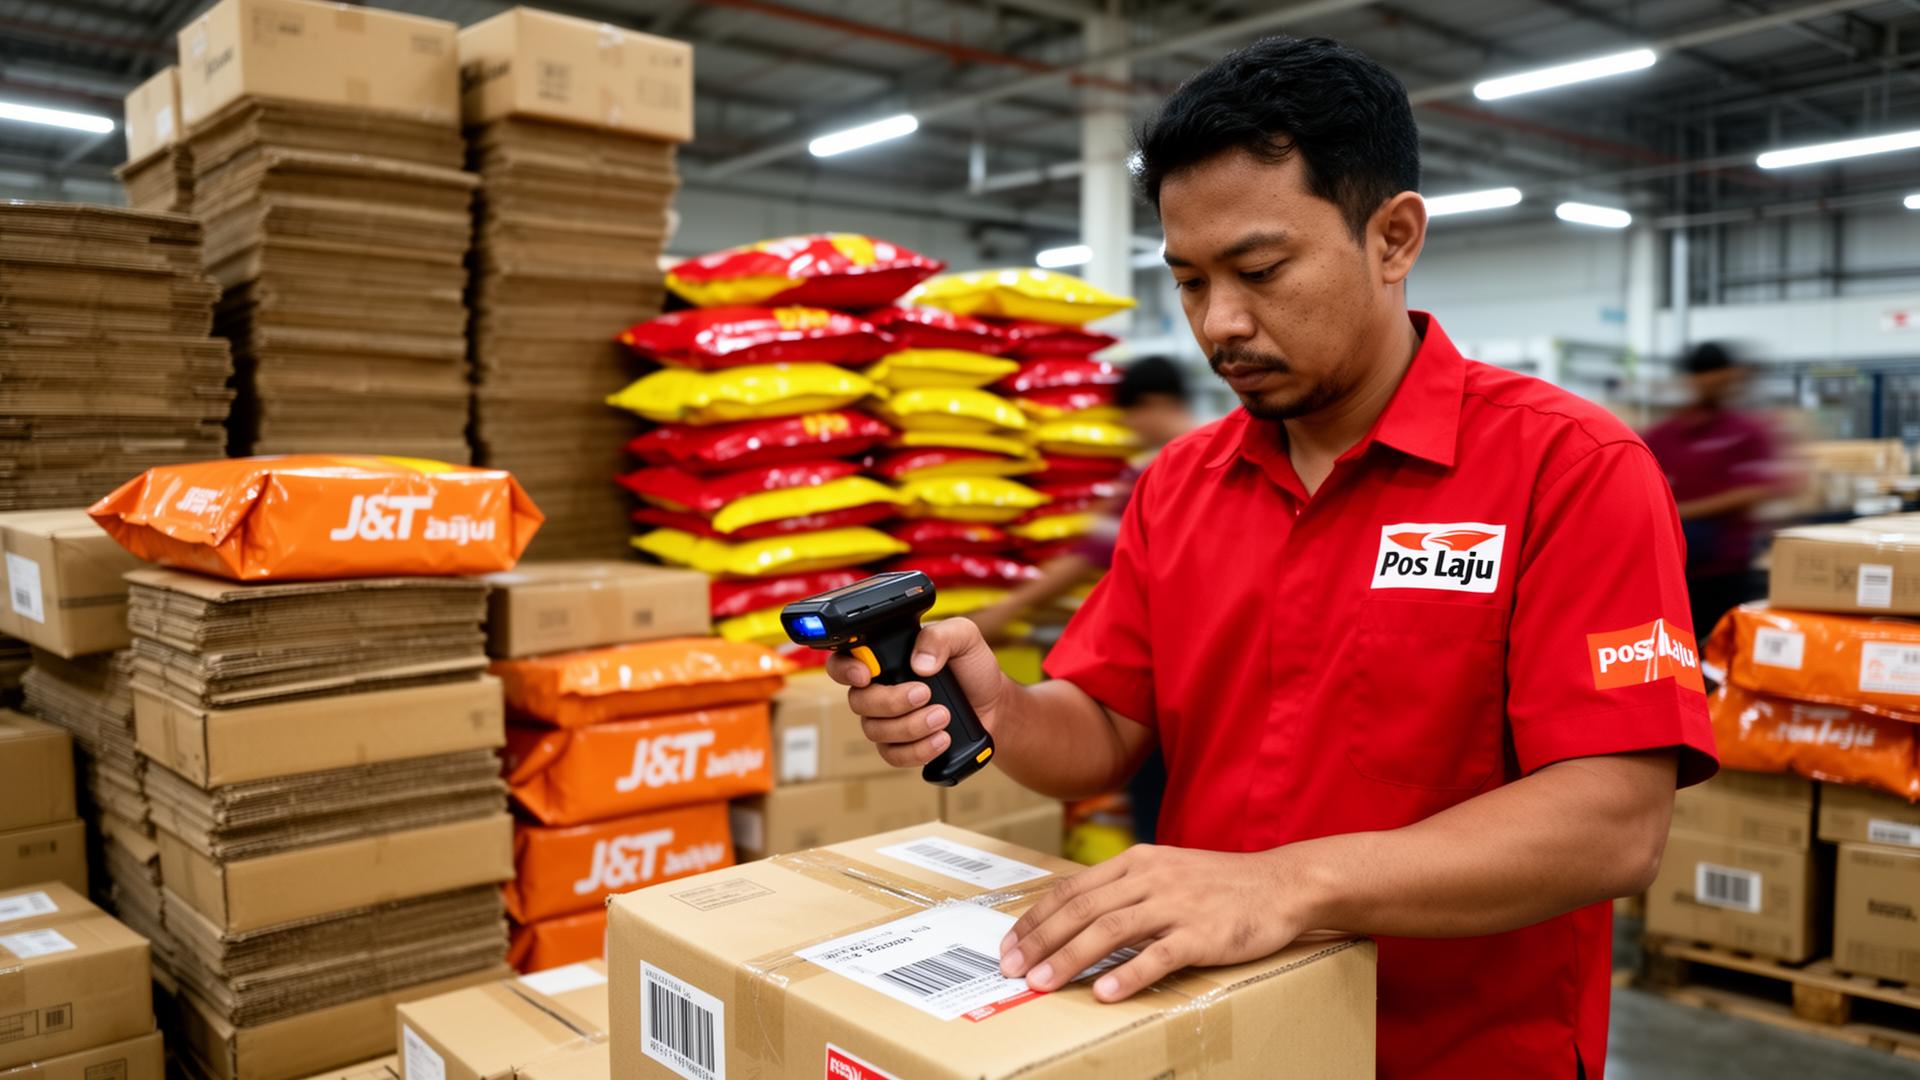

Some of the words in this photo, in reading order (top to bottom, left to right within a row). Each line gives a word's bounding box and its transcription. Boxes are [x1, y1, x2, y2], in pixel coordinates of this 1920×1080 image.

[330, 494, 435, 541] J&T
[1380, 551, 1429, 576] Pos
[1434, 550, 1495, 586] Laju
[615, 730, 715, 792] J&T
[573, 828, 675, 896] J&T
